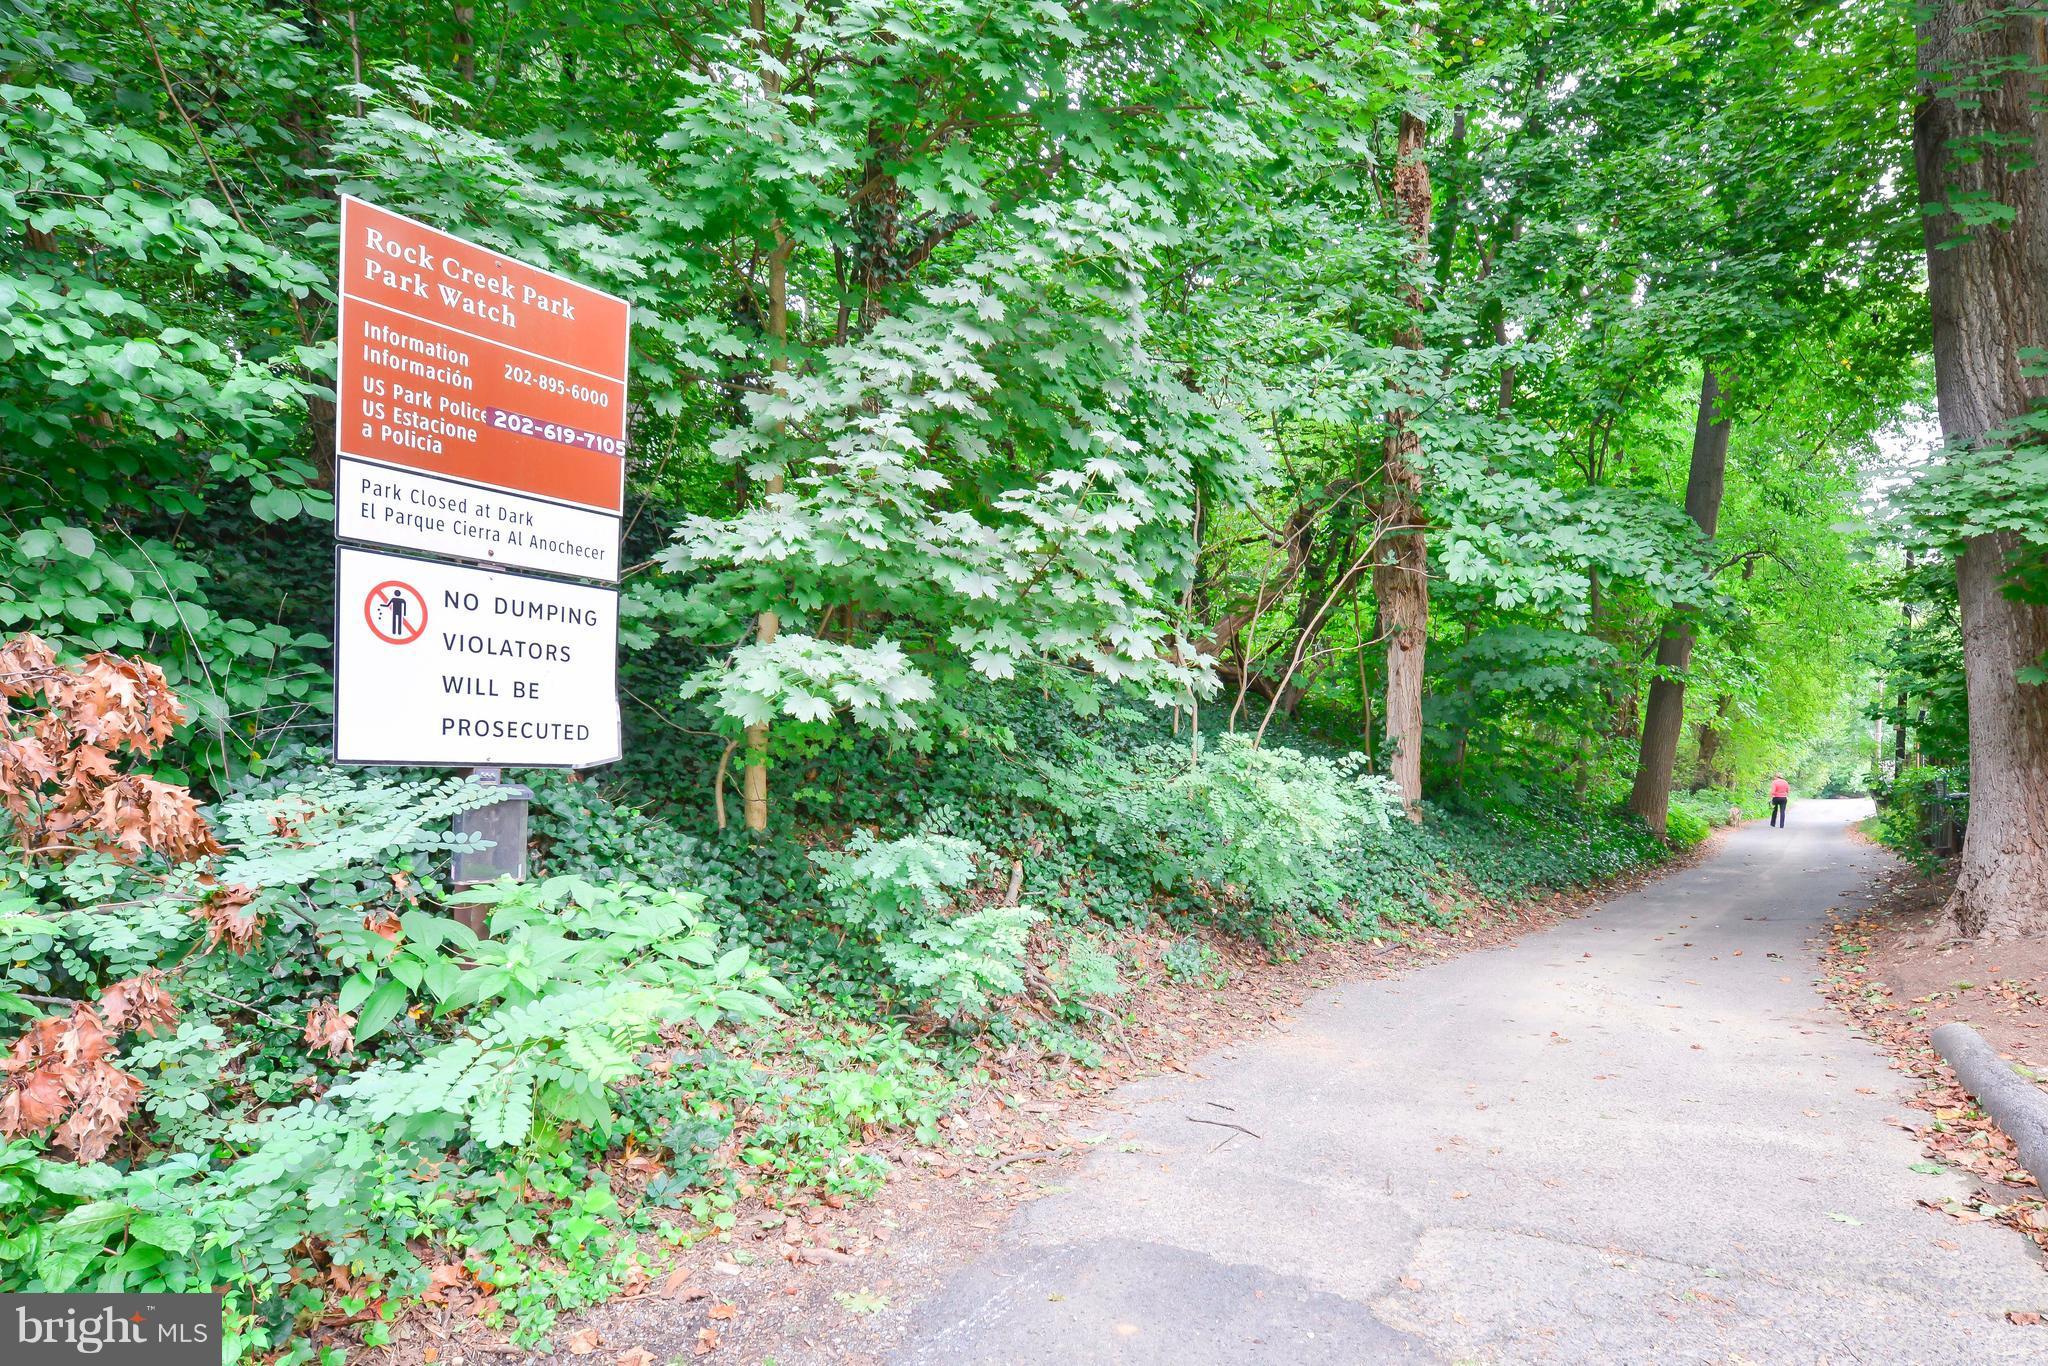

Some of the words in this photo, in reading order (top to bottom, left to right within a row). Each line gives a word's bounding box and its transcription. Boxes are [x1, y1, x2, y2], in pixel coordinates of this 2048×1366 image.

[364, 257, 430, 299] Park
[437, 283, 516, 328] Watch
[365, 227, 434, 271] Rock
[442, 256, 515, 299] Creek
[522, 285, 576, 320] Park
[364, 320, 470, 367] Information
[363, 345, 473, 390] Información
[503, 364, 609, 408] 202-895-6000
[363, 376, 386, 397] US
[393, 383, 432, 409] Park
[361, 424, 373, 438] a
[381, 424, 443, 454] Policía
[362, 399, 385, 420] US
[393, 407, 478, 443] Estacione
[493, 410, 626, 456] 202-619-7105
[361, 478, 402, 501] Park
[410, 488, 468, 514] Closed
[475, 503, 491, 519] at
[498, 506, 534, 527] Dark
[361, 502, 376, 520] El
[385, 507, 446, 533] Parque
[453, 520, 501, 542] Cierra
[508, 530, 523, 546] Al
[530, 534, 605, 561] Anochecer
[444, 590, 479, 611] NO
[494, 597, 598, 627] DUMPING
[442, 632, 571, 663] VIOLATORS
[442, 675, 499, 697] WILL
[513, 681, 539, 700] BE
[442, 718, 590, 741] PROSECUTED
